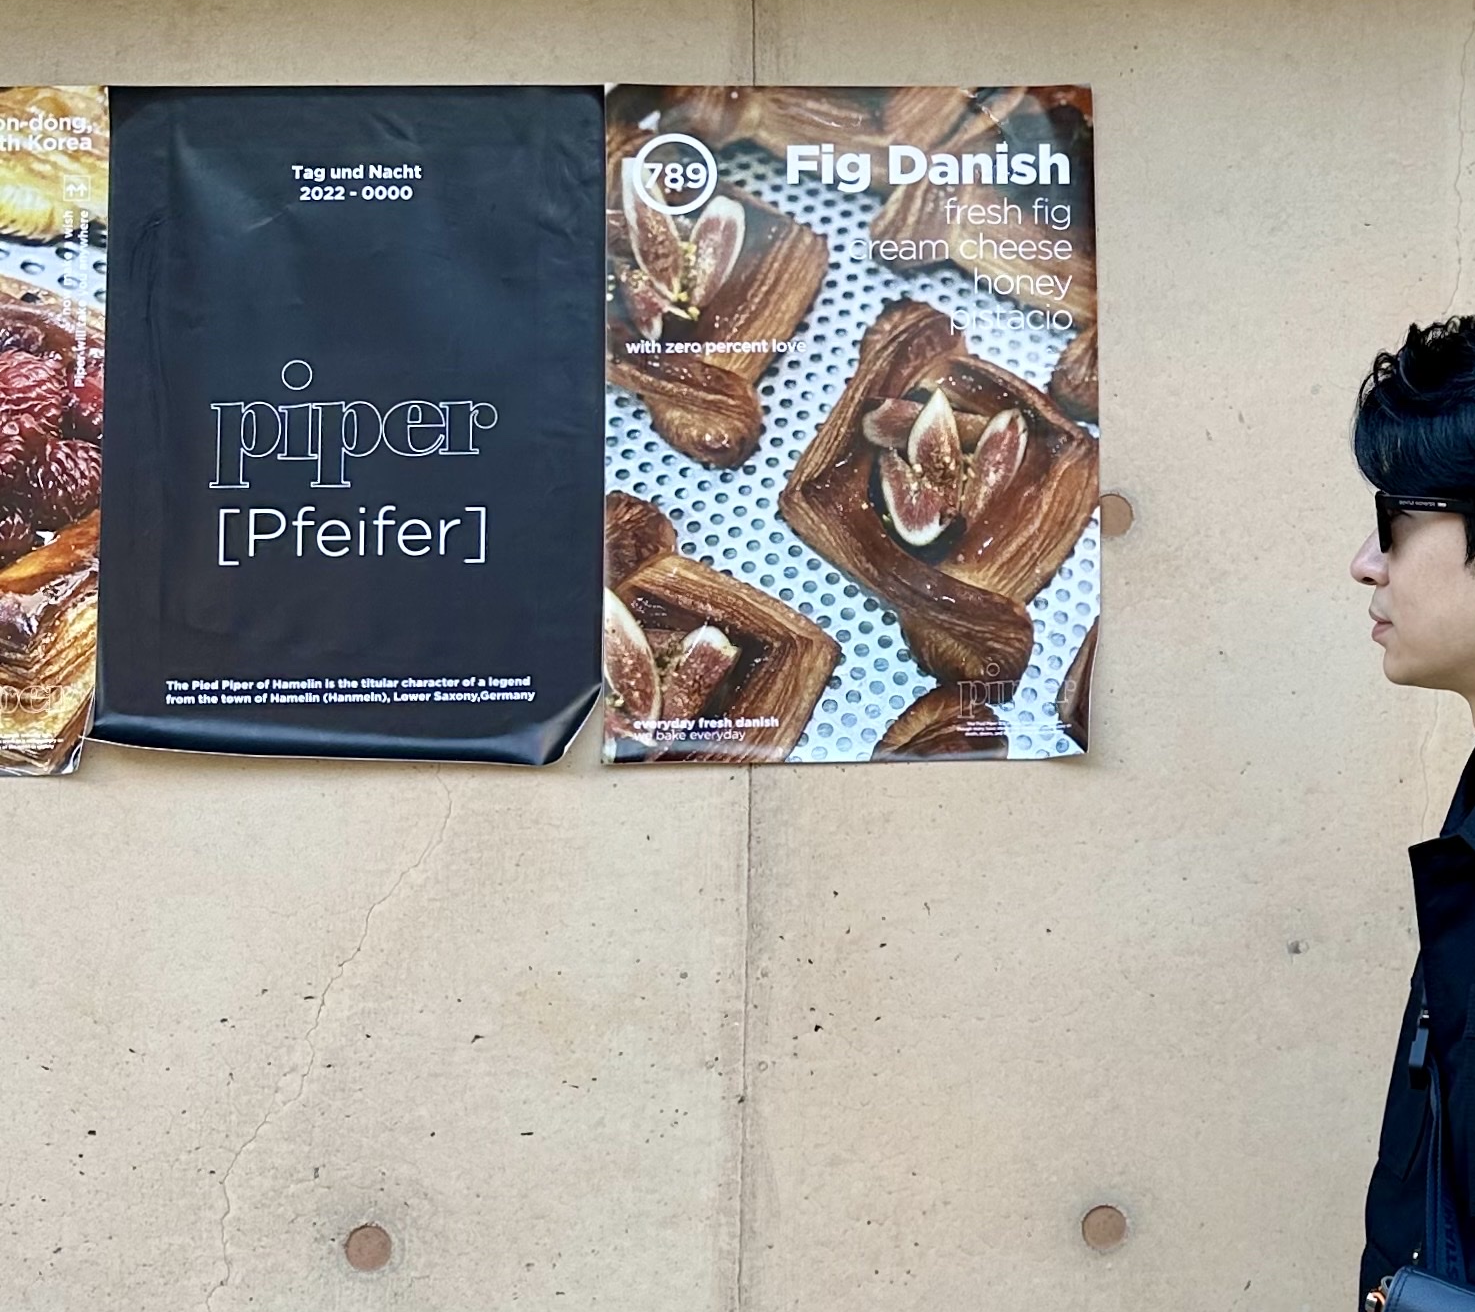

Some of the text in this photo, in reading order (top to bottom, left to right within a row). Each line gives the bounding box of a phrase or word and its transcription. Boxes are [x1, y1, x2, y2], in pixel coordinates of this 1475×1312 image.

[28, 134, 92, 151] Korea
[291, 164, 422, 182] Tag und Nacht
[644, 163, 707, 189] 789
[786, 142, 1071, 193] Fig Danish
[299, 186, 345, 201] 2022
[361, 185, 413, 201] 0000
[63, 210, 73, 239] wish
[944, 197, 1071, 230] fresh fig
[77, 210, 90, 270] anywhere
[849, 233, 1073, 260] cream cheese
[974, 267, 1073, 301] honey
[950, 304, 1073, 335] pistacio
[75, 330, 87, 351] will
[625, 339, 807, 357] with zero percent love
[74, 353, 87, 388] Piper
[209, 359, 498, 489] piper
[218, 505, 487, 566] [Pfeifer]
[166, 676, 531, 692] The Pied Piper of Hamelin is the titular character of a legend
[166, 694, 195, 704] from
[198, 694, 218, 704] the
[221, 694, 251, 703] town
[254, 693, 267, 703] of
[270, 693, 320, 703] Hamelin
[394, 692, 431, 702] Lower
[633, 717, 779, 730] everyday fresh danish
[656, 730, 686, 740] bake
[689, 730, 746, 741] everyday
